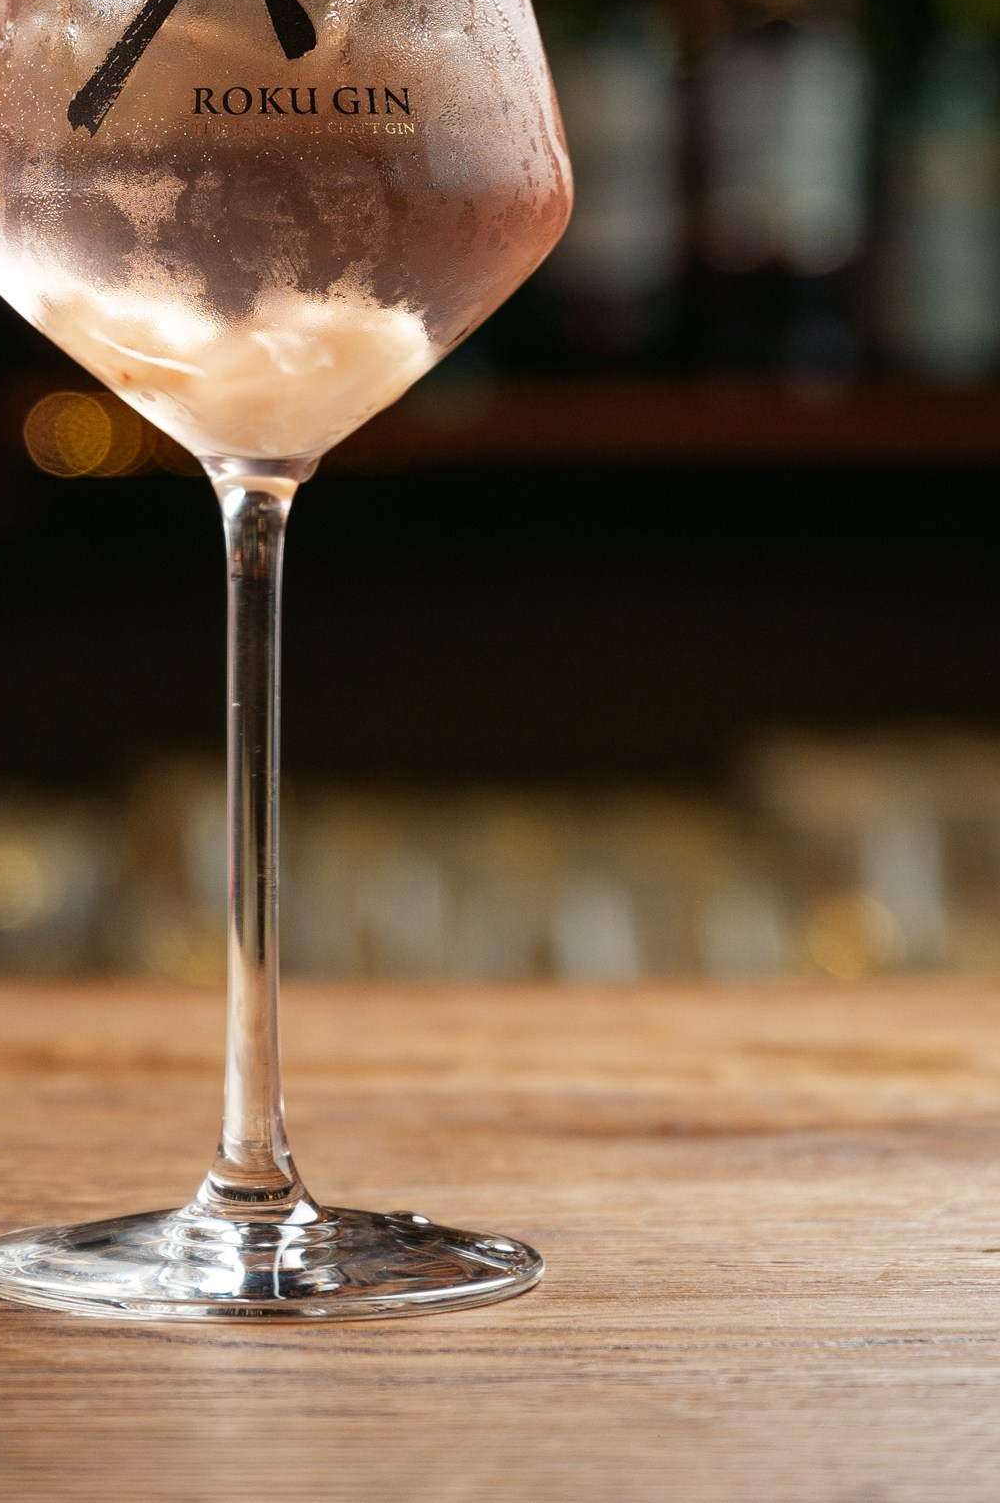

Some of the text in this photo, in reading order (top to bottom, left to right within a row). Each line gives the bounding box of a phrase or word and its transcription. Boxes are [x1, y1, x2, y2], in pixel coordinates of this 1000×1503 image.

[192, 86, 411, 115] ROKU GIN
[235, 122, 321, 136] JAPASE
[327, 121, 380, 134] CRAFT
[385, 122, 415, 135] GIN
